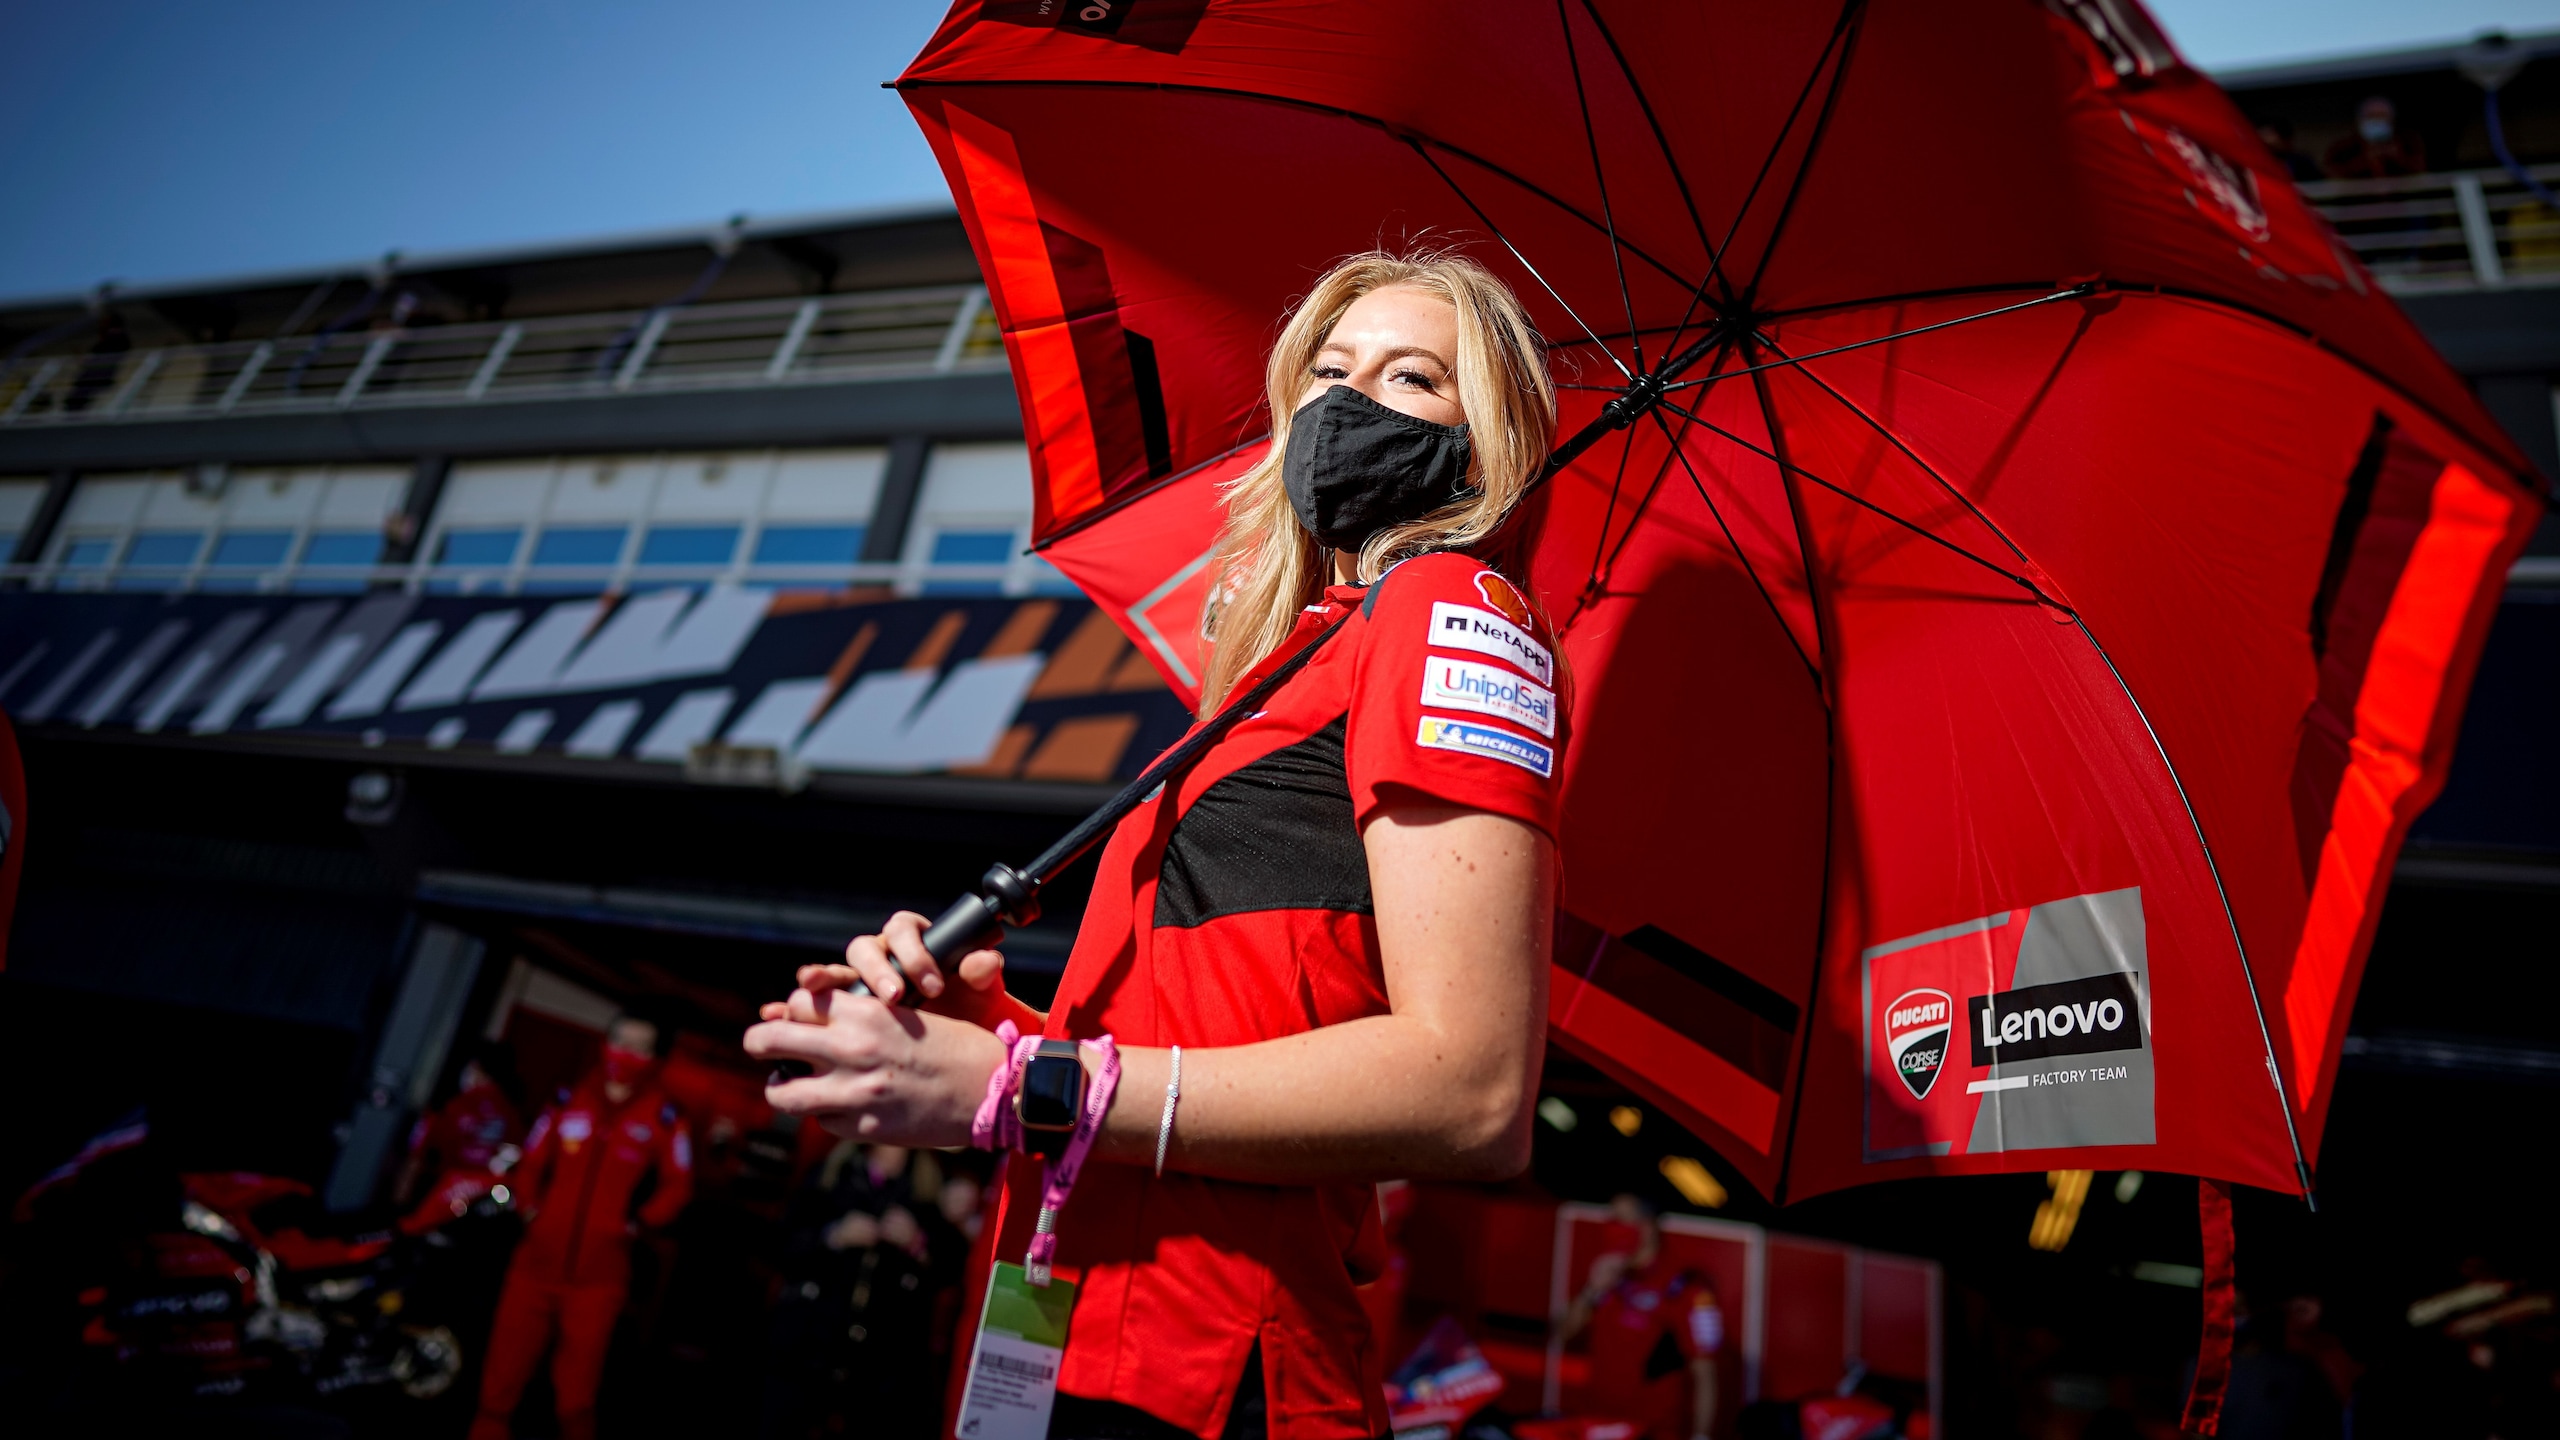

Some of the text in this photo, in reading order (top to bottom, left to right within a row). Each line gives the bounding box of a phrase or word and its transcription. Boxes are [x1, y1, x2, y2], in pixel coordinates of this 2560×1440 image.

[1474, 620, 1545, 668] NetApp
[1445, 667, 1548, 719] UnipolSai
[1465, 734, 1545, 765] MICHELIN
[1892, 1001, 1946, 1029] DUCATI
[1982, 998, 2124, 1047] Lenovo
[1901, 1048, 1939, 1070] CORSE
[2033, 1066, 2127, 1087] FACTORY TEAM
